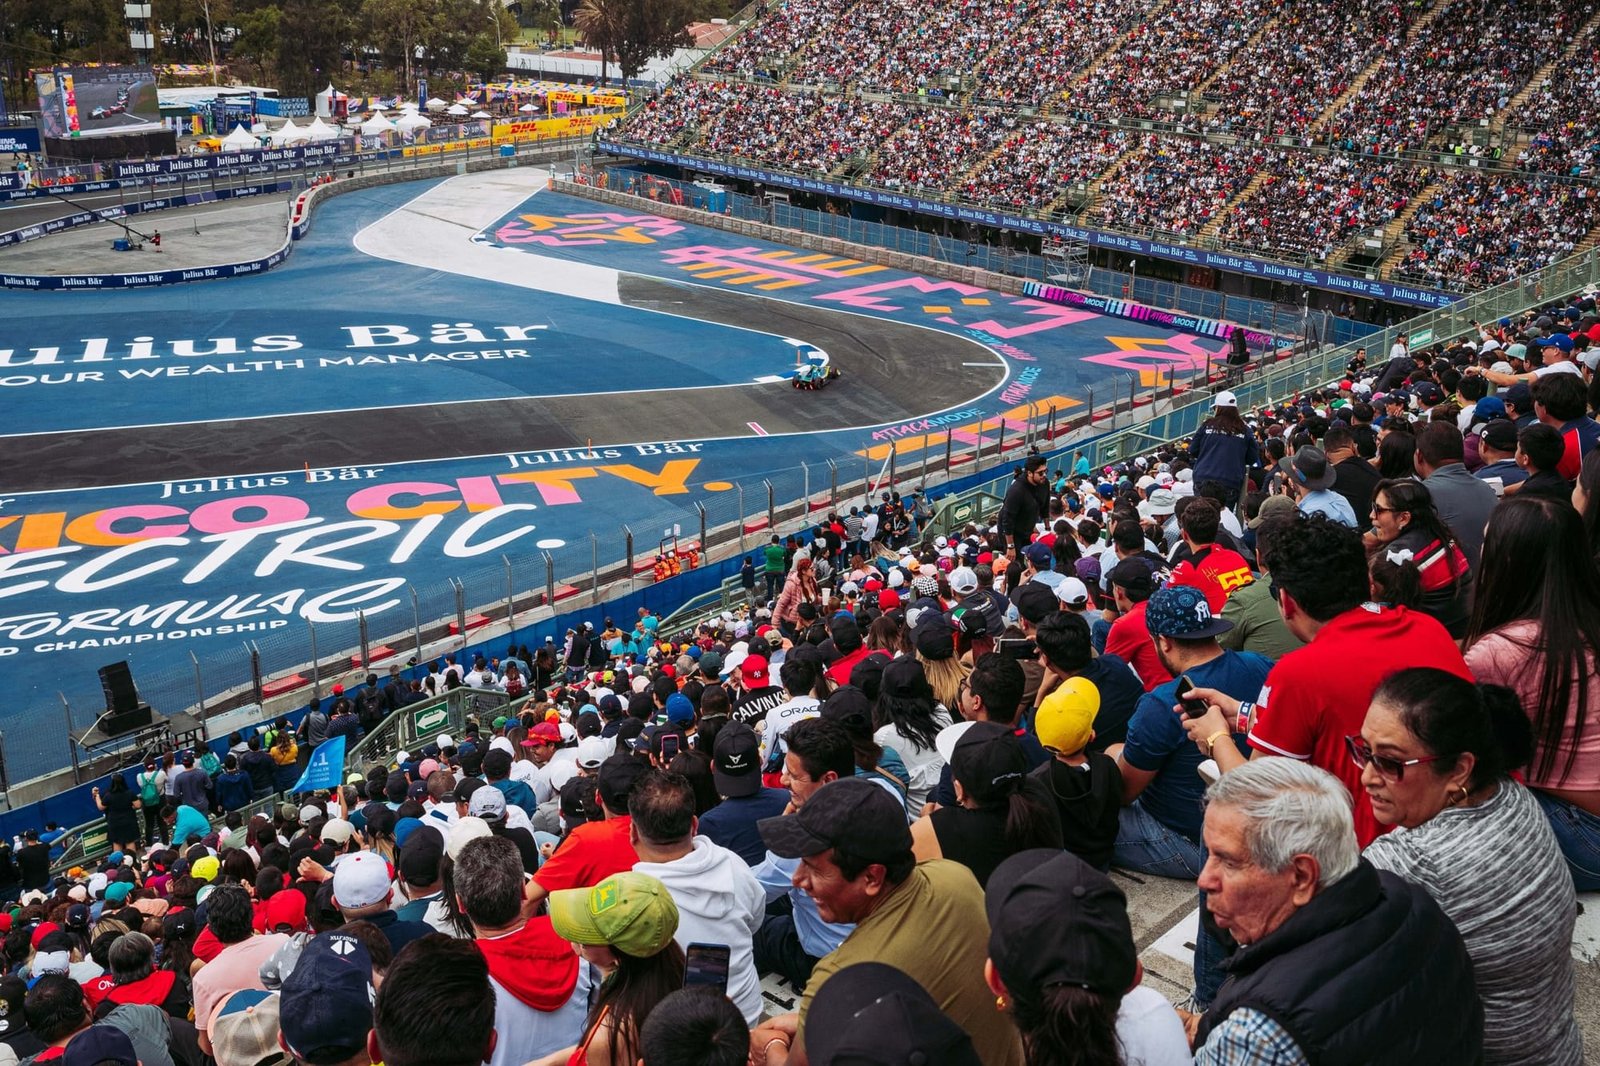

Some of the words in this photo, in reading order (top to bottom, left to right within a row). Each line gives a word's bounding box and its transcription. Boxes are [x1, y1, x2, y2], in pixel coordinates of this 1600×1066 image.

[555, 93, 576, 101] DHL
[593, 97, 617, 105] DHL
[510, 123, 538, 134] DHL
[569, 117, 592, 127] DHL
[262, 152, 282, 162] Julius
[283, 150, 296, 159] Bär
[304, 148, 323, 158] Julius
[324, 146, 336, 154] Bär
[170, 161, 193, 172] Julius
[194, 159, 208, 169] Bär
[217, 157, 239, 167] Julius
[240, 154, 253, 163] Bär
[119, 165, 143, 177] Julius
[145, 164, 160, 173] Bär
[0, 177, 13, 187] är
[959, 208, 974, 218] Julius
[975, 211, 986, 220] Bär
[1003, 217, 1019, 227] Julius
[1020, 219, 1031, 229] Bär
[1098, 234, 1116, 245] Julius
[1117, 236, 1129, 247] Bär
[1150, 243, 1169, 255] Julius
[1171, 246, 1184, 257] Bär
[1206, 253, 1227, 265] Julius
[1228, 257, 1242, 268] Bär
[183, 270, 204, 280] Julius
[205, 268, 218, 277] Bär
[234, 264, 250, 274] Julius
[252, 262, 260, 271] Bär
[1263, 264, 1285, 276] Julius
[1287, 268, 1301, 279] Bär
[4, 277, 24, 286] Julius
[62, 278, 86, 287] Julius
[88, 277, 103, 285] Bär
[124, 276, 147, 286] Julius
[149, 274, 163, 283] Bär
[1327, 275, 1350, 288] Julius
[1352, 280, 1368, 291] Bär
[1393, 287, 1418, 300] Julius
[1419, 291, 1436, 303] Bär
[340, 322, 549, 348] Bär
[117, 358, 305, 380] WEALTH
[319, 348, 532, 367] MANAGER
[506, 446, 622, 469] Julius
[635, 441, 703, 456] Bär
[160, 473, 289, 499] Julius
[307, 467, 385, 484] Bär
[35, 619, 288, 653] CHAMPIONSHIP
[732, 695, 774, 724] CALVIN
